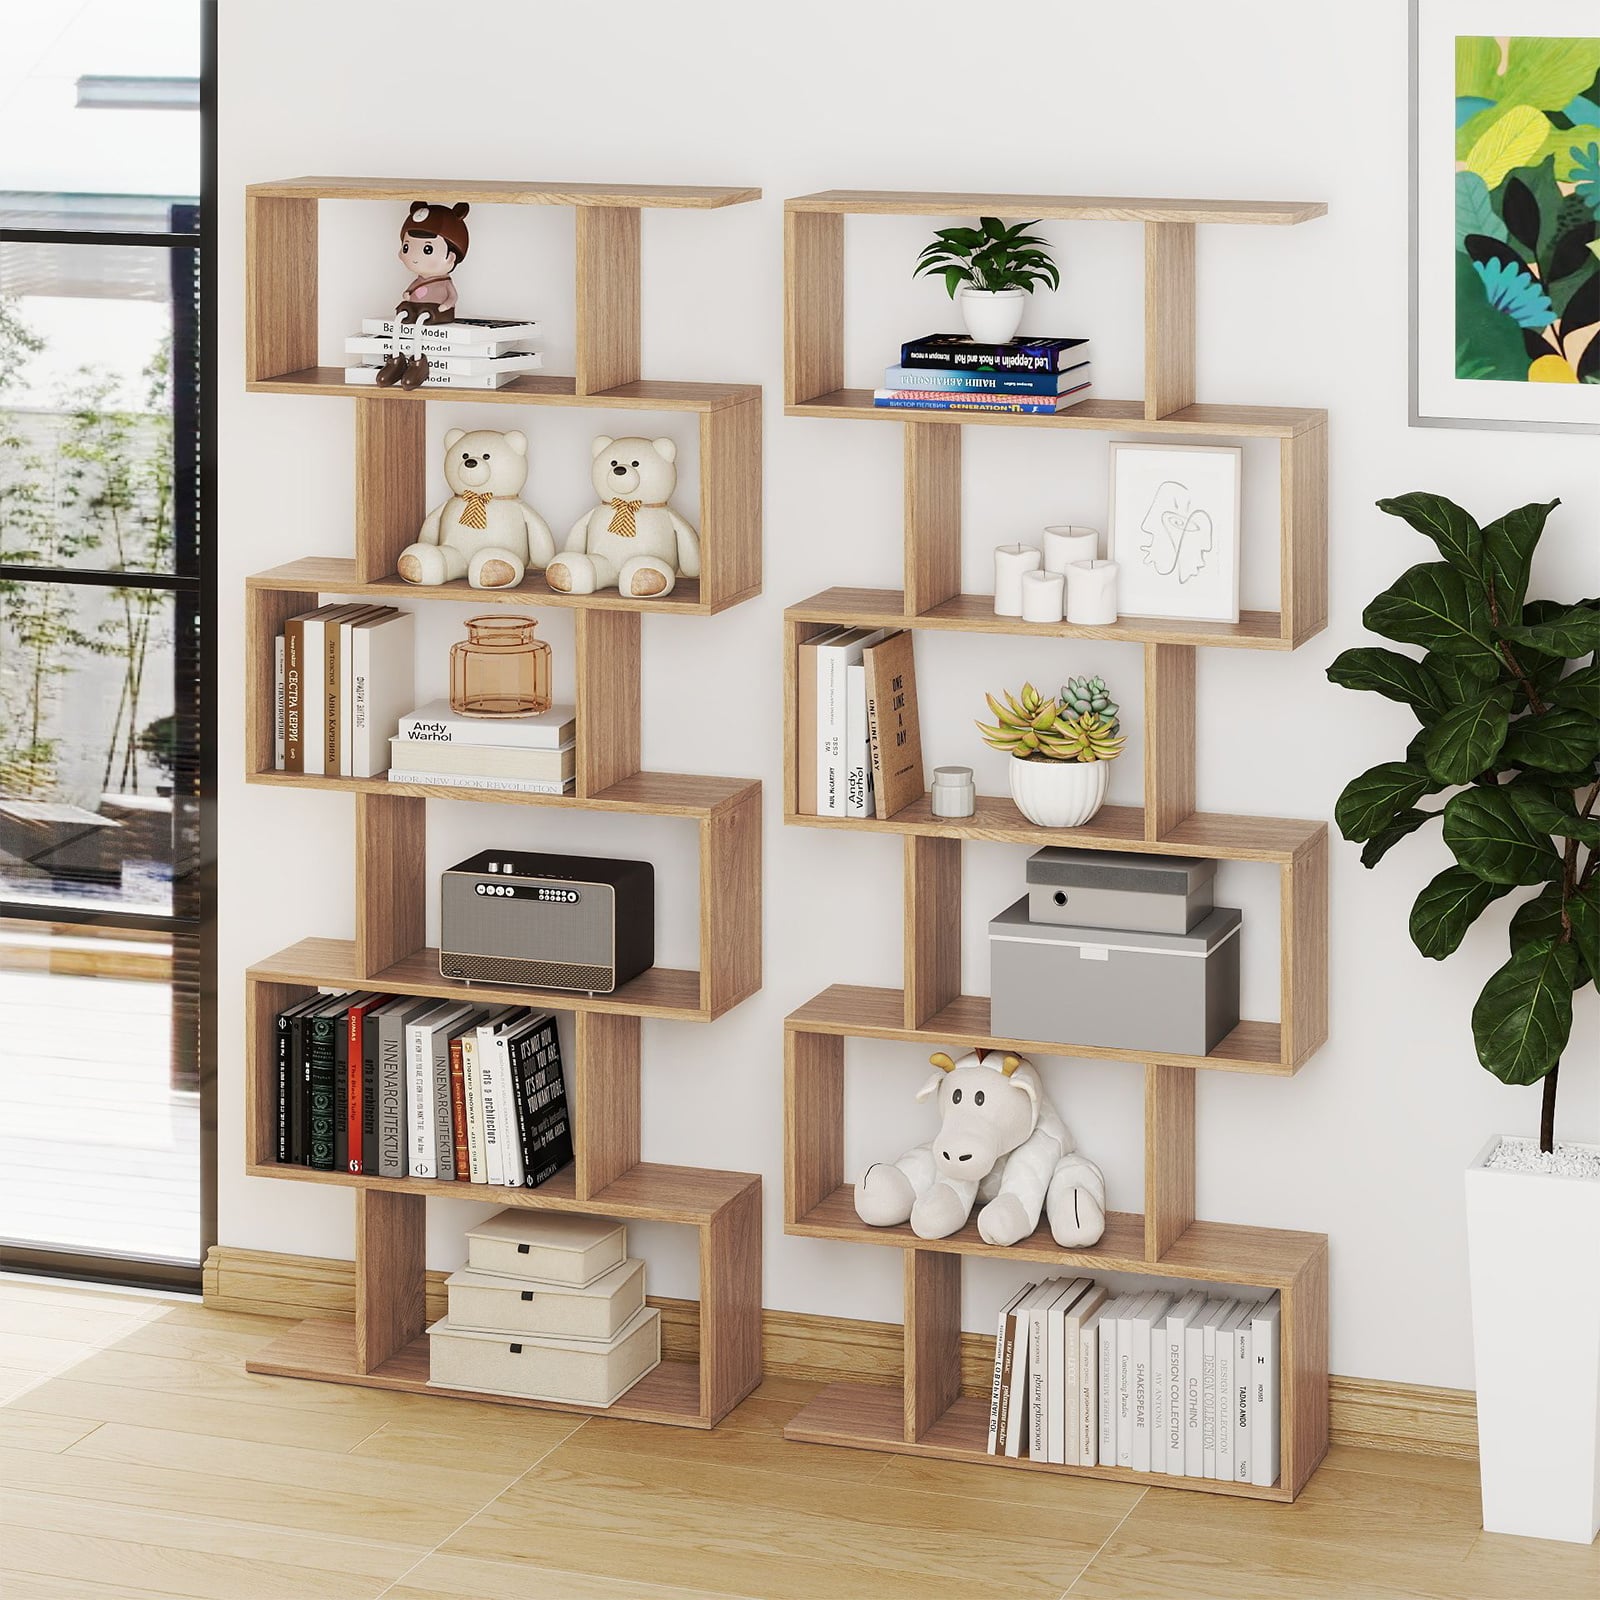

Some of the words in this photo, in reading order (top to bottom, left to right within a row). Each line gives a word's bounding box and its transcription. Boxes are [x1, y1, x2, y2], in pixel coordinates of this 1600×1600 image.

[427, 360, 449, 370] odel
[954, 354, 966, 364] Roll
[967, 354, 977, 364] and
[978, 354, 994, 365] Rock
[995, 355, 1001, 364] in
[1002, 353, 1033, 369] Zeppelin
[1034, 357, 1049, 370] Led
[965, 378, 996, 388] НАШИ
[889, 400, 915, 408] ВИКТОР
[949, 403, 1008, 412] GENERATION
[288, 670, 299, 708] СЕСТРА
[288, 710, 299, 742] КЕРРИ
[407, 731, 452, 742] Warhol
[413, 721, 447, 734] Andy
[425, 776, 450, 785] NEW
[453, 777, 484, 788] LOOK
[486, 780, 558, 793] REVOLUTION
[848, 770, 857, 804] Andy
[856, 766, 864, 809] Warhol
[520, 1040, 531, 1060] IT'S
[482, 1069, 492, 1085] arts
[525, 1076, 536, 1097] IT'S
[383, 1039, 399, 1168] INNENARCHITEKTUR
[435, 1055, 451, 1171] INNENARCHITEKTUR
[484, 1097, 497, 1145] architecture
[1170, 1344, 1180, 1382] DESIGN
[1204, 1354, 1214, 1391] DESIGN
[1219, 1359, 1228, 1394] DESIGN
[1136, 1363, 1145, 1428] SHAKESPEARE
[1189, 1377, 1198, 1428] CLOTHING
[1239, 1386, 1247, 1408] TADAO
[1170, 1384, 1180, 1450] COLLECTION
[1204, 1392, 1214, 1451] COLLECTION
[1219, 1395, 1228, 1455] COLLECTION
[1239, 1409, 1247, 1428] ANDO
